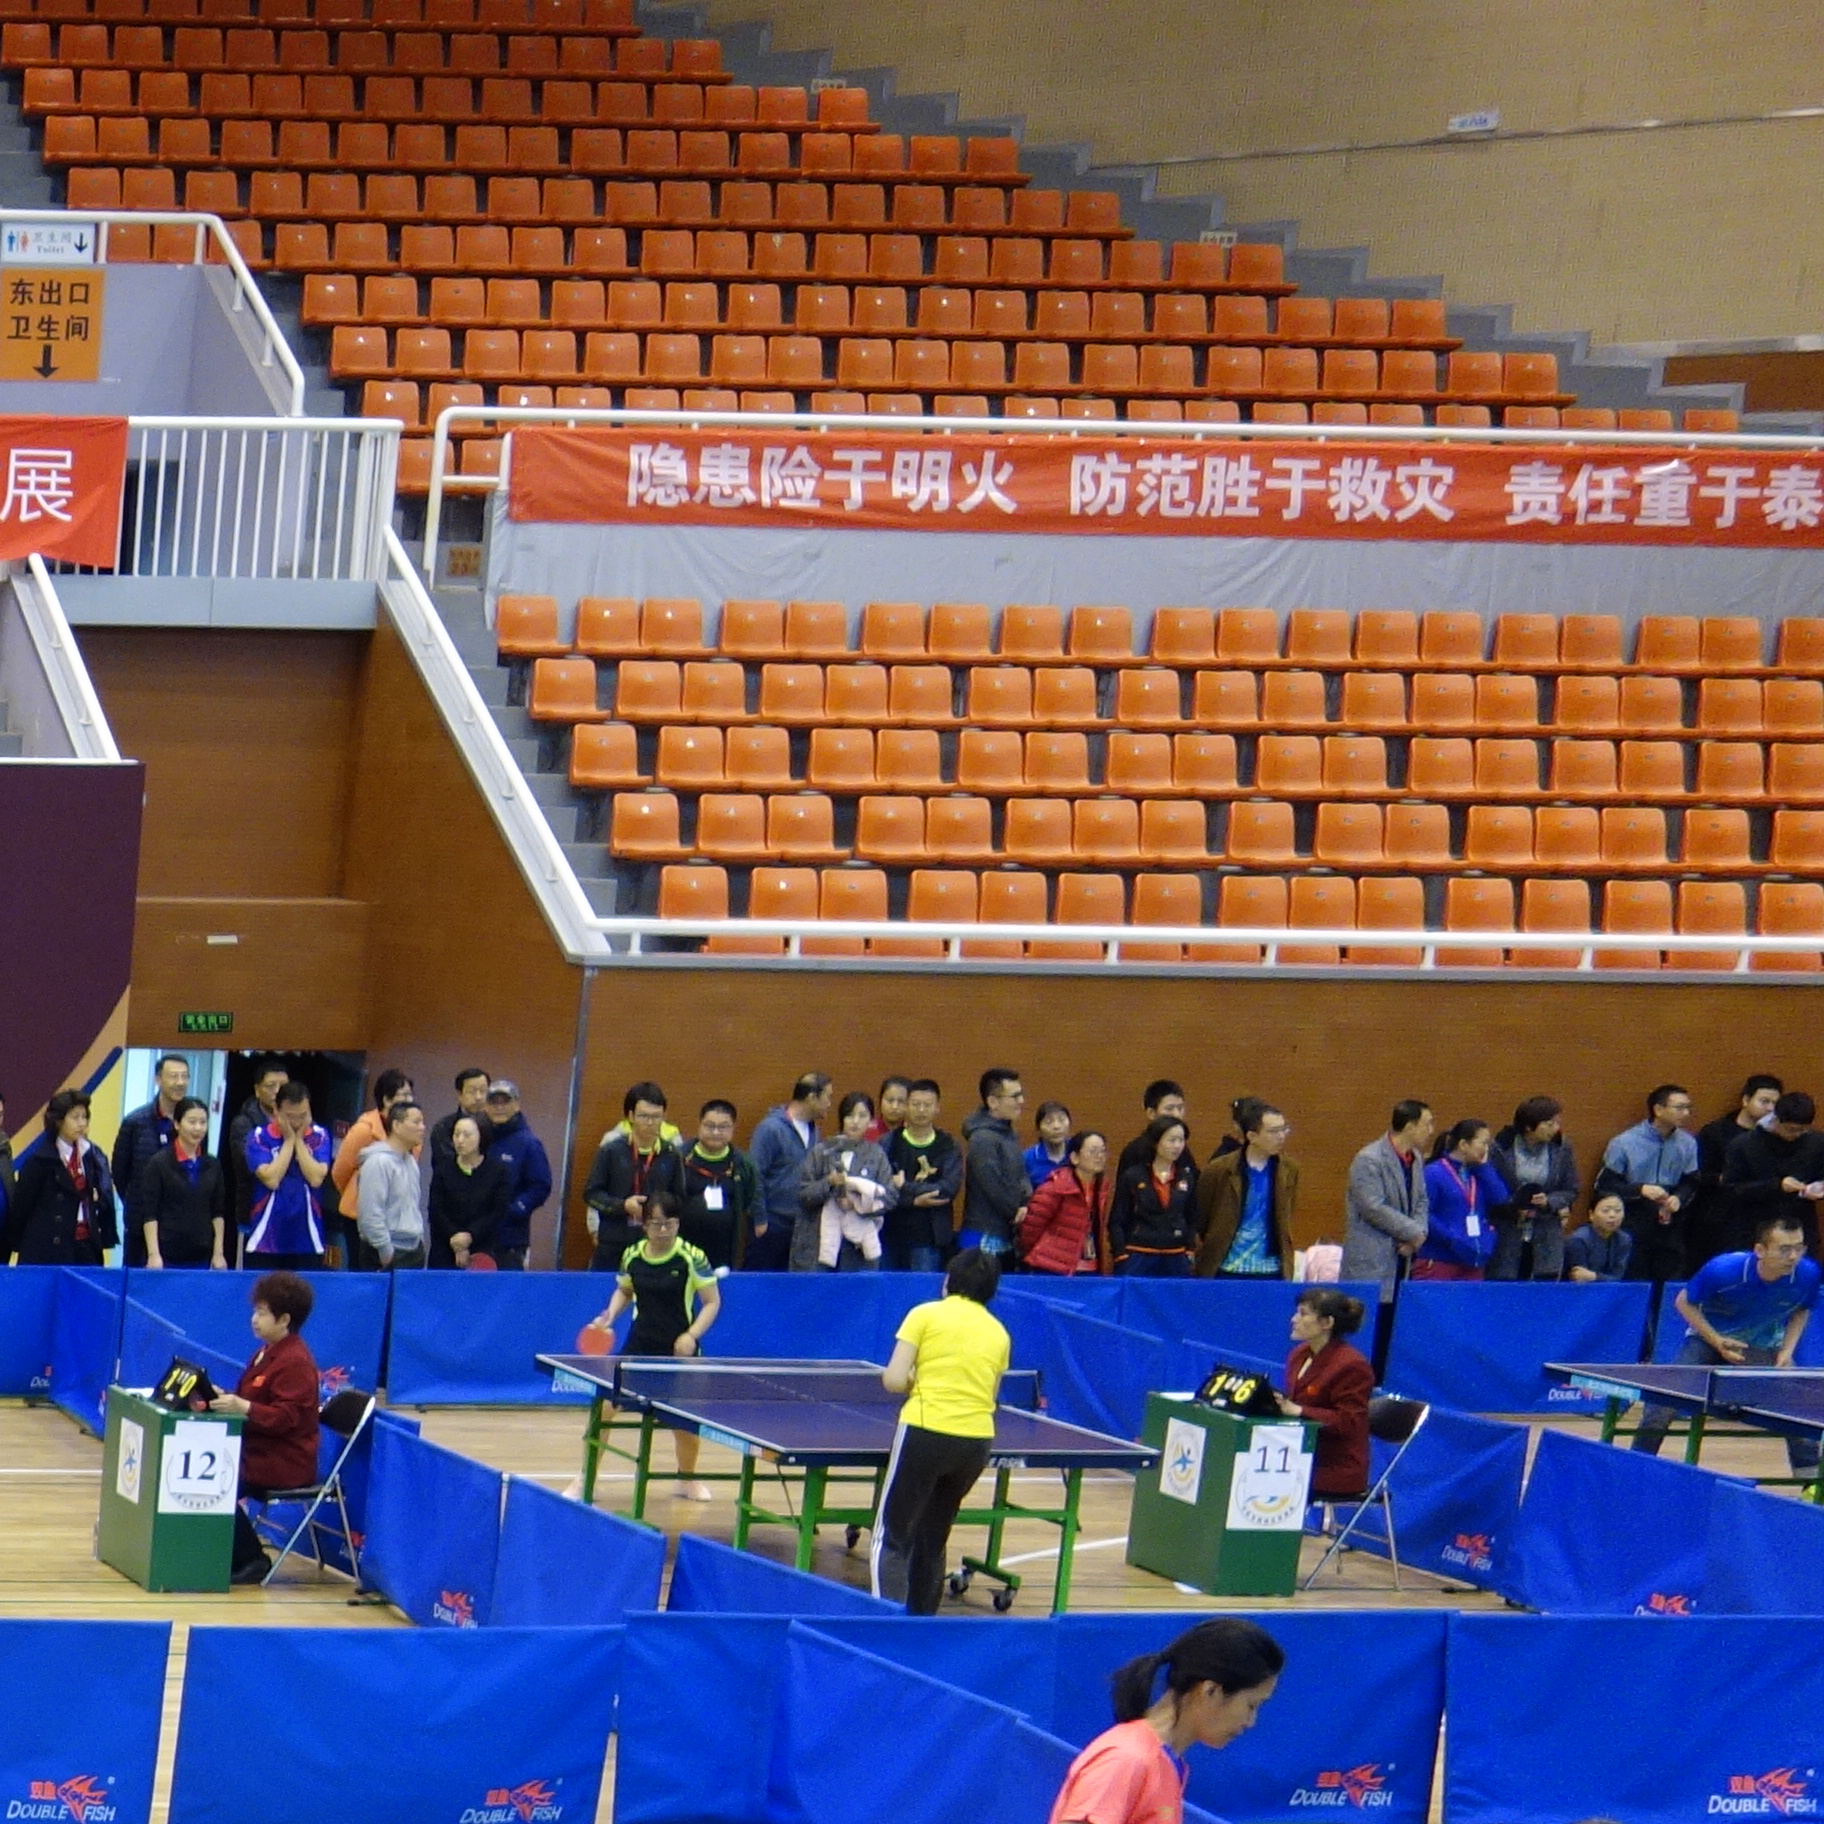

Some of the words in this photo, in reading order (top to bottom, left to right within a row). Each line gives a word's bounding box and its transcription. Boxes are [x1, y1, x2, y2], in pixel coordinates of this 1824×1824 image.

[10, 278, 90, 306] 东出口
[7, 315, 89, 341] 卫生间
[626, 443, 1018, 514] 隐患险于明火
[1069, 451, 1456, 523] 防范胜于救灾
[1504, 459, 1824, 531] 责任重于泰
[177, 1450, 217, 1481] 12
[1254, 1446, 1291, 1473] 11
[6, 1798, 69, 1820] DOUBLE
[84, 1804, 117, 1821] FISH
[1290, 1788, 1348, 1806] DOUBLE
[1361, 1790, 1393, 1806] FISH
[1707, 1794, 1770, 1814] DOUBLE
[1785, 1797, 1818, 1814] FISH
[459, 1806, 515, 1824] DOUBLE
[534, 1806, 562, 1821] FISH
